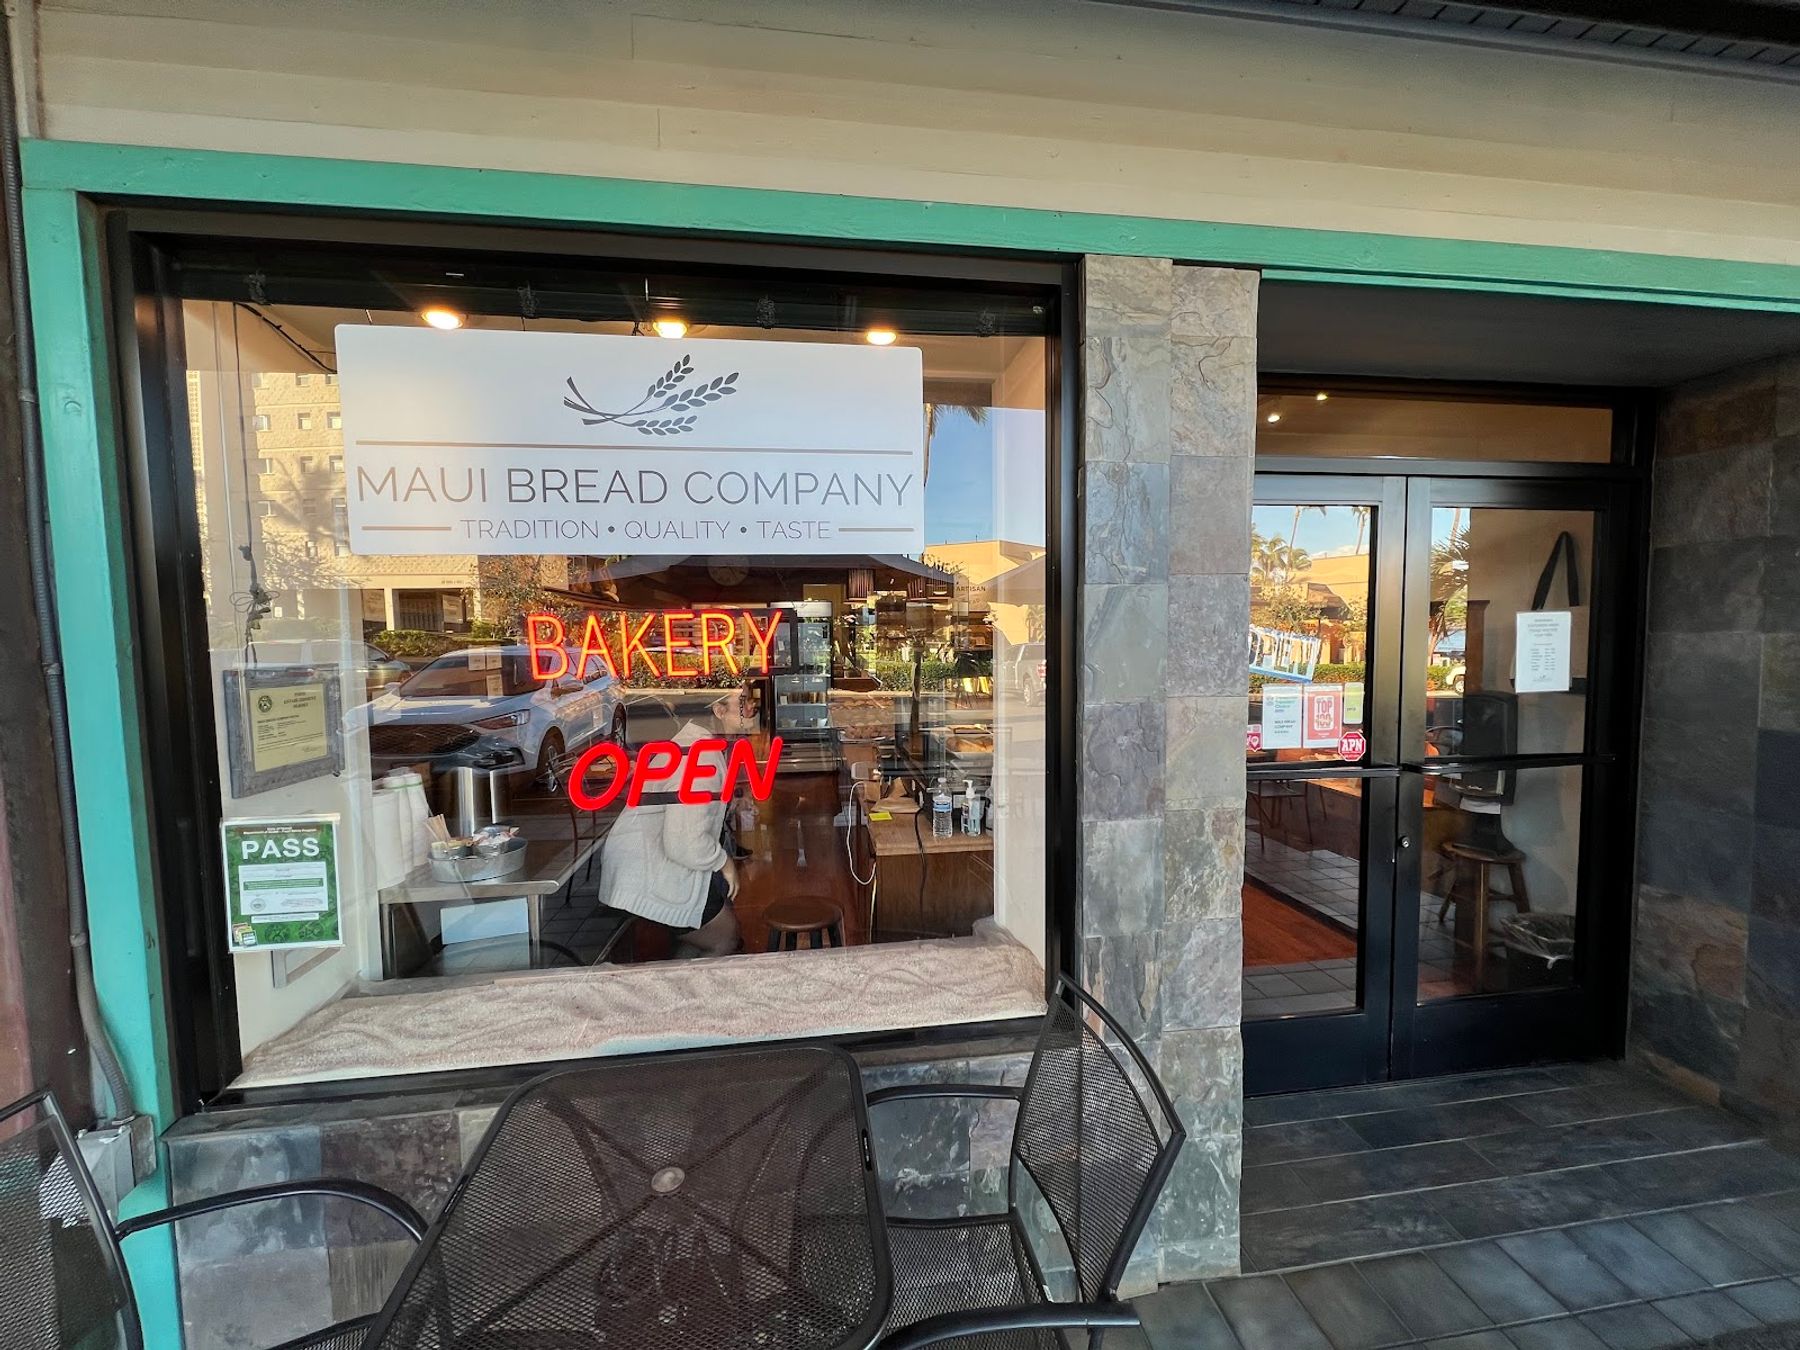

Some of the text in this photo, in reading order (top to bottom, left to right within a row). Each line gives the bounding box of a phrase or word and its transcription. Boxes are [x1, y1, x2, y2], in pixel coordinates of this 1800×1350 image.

[356, 465, 914, 507] MAUI BREAD COMPANY
[459, 519, 832, 541] TRADITION QUALITY TASTE
[527, 610, 783, 682] BAKERY
[1316, 700, 1332, 713] TOP
[1341, 738, 1363, 752] APN
[567, 736, 784, 811] OPEN
[241, 837, 320, 860] PASS
